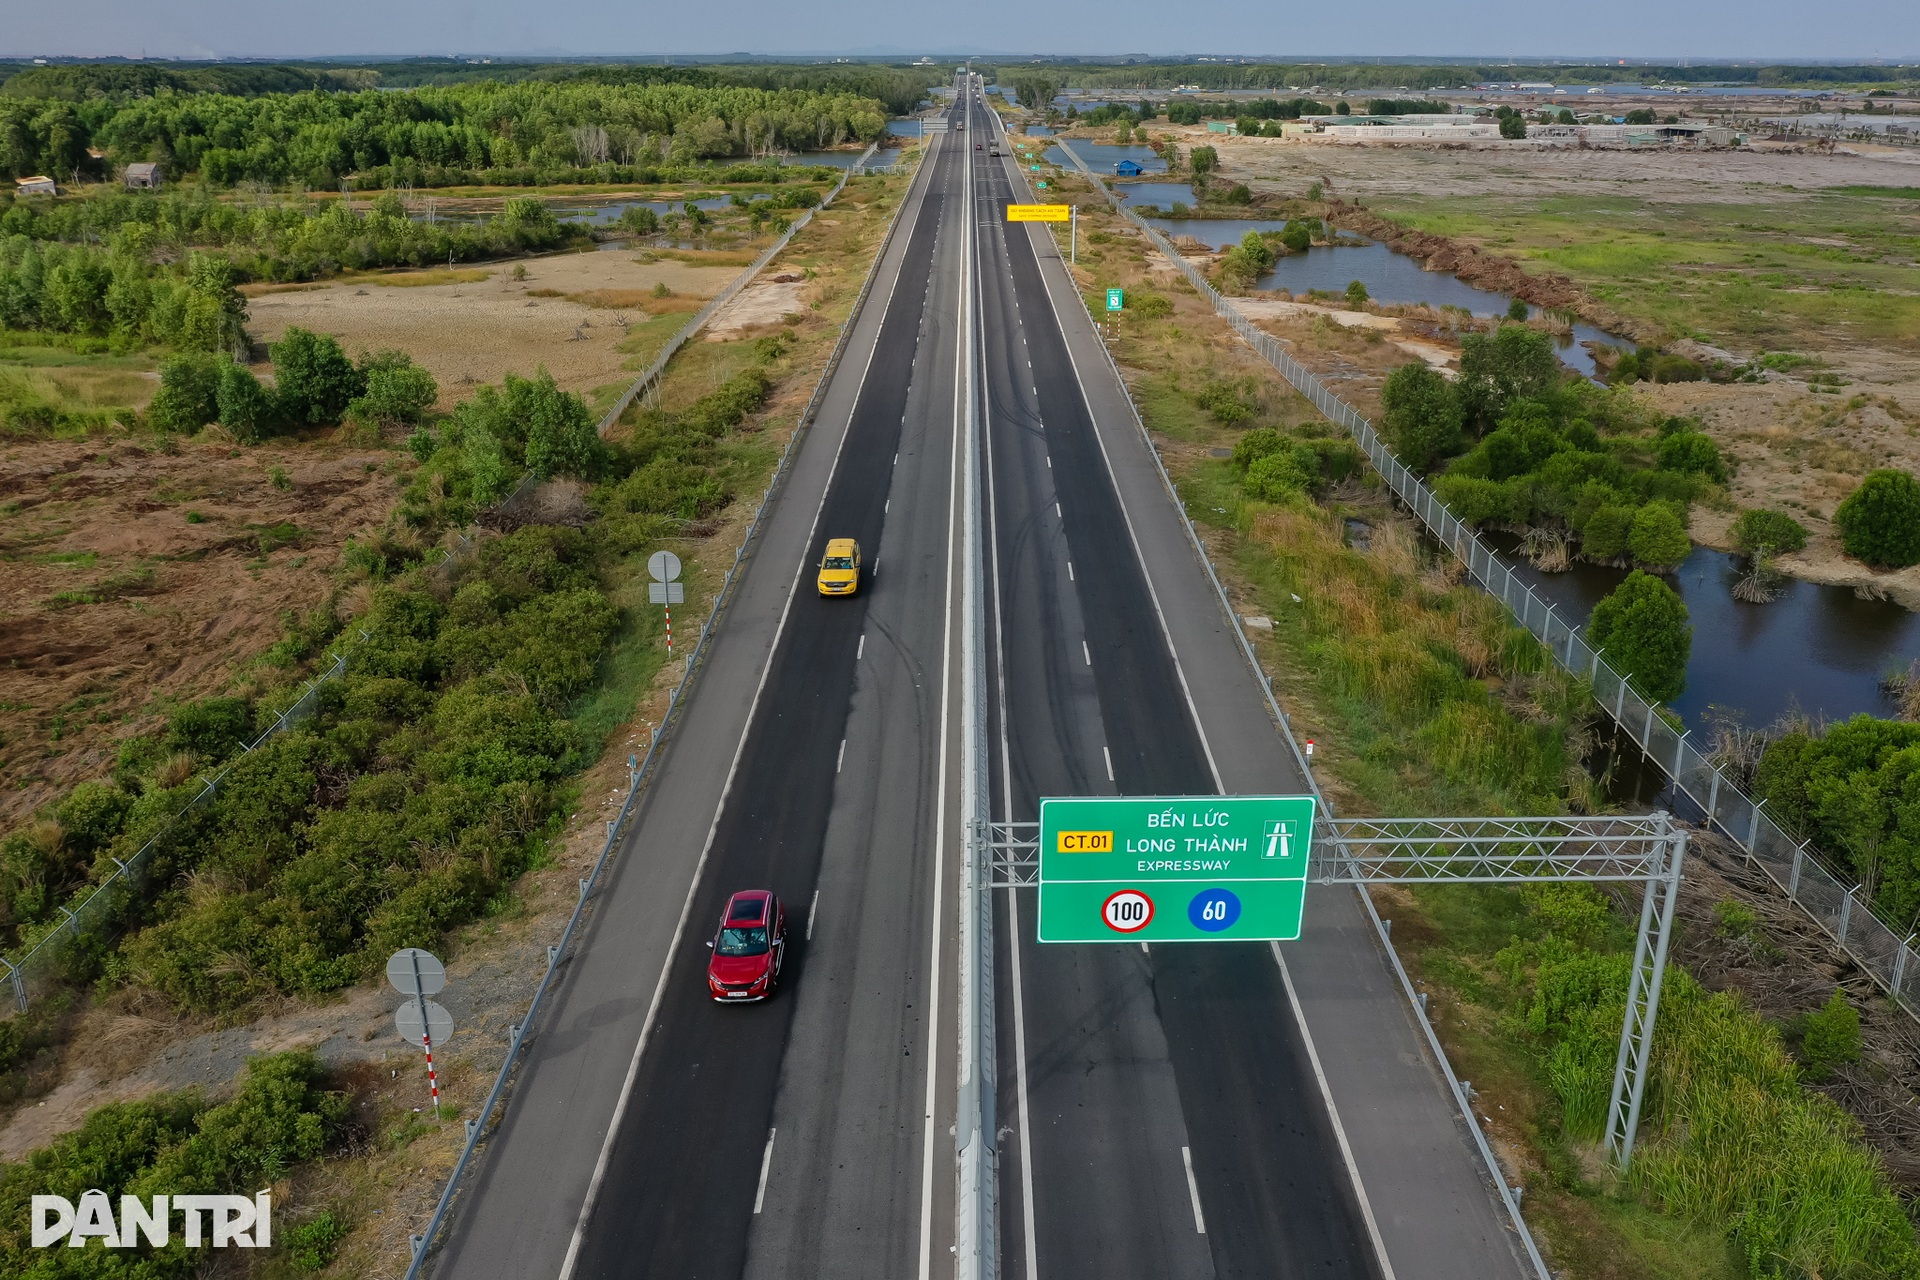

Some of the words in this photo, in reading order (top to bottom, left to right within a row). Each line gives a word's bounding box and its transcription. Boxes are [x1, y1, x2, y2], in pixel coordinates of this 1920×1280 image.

[1147, 807, 1186, 828] BẾN
[1192, 808, 1230, 827] LỨC
[1063, 835, 1107, 849] CT.01
[1126, 838, 1176, 853] LONG
[1183, 834, 1248, 852] THÀNH
[1137, 860, 1231, 872] EXPRESSWAY
[1111, 901, 1143, 921] 100
[1202, 900, 1226, 921] 60
